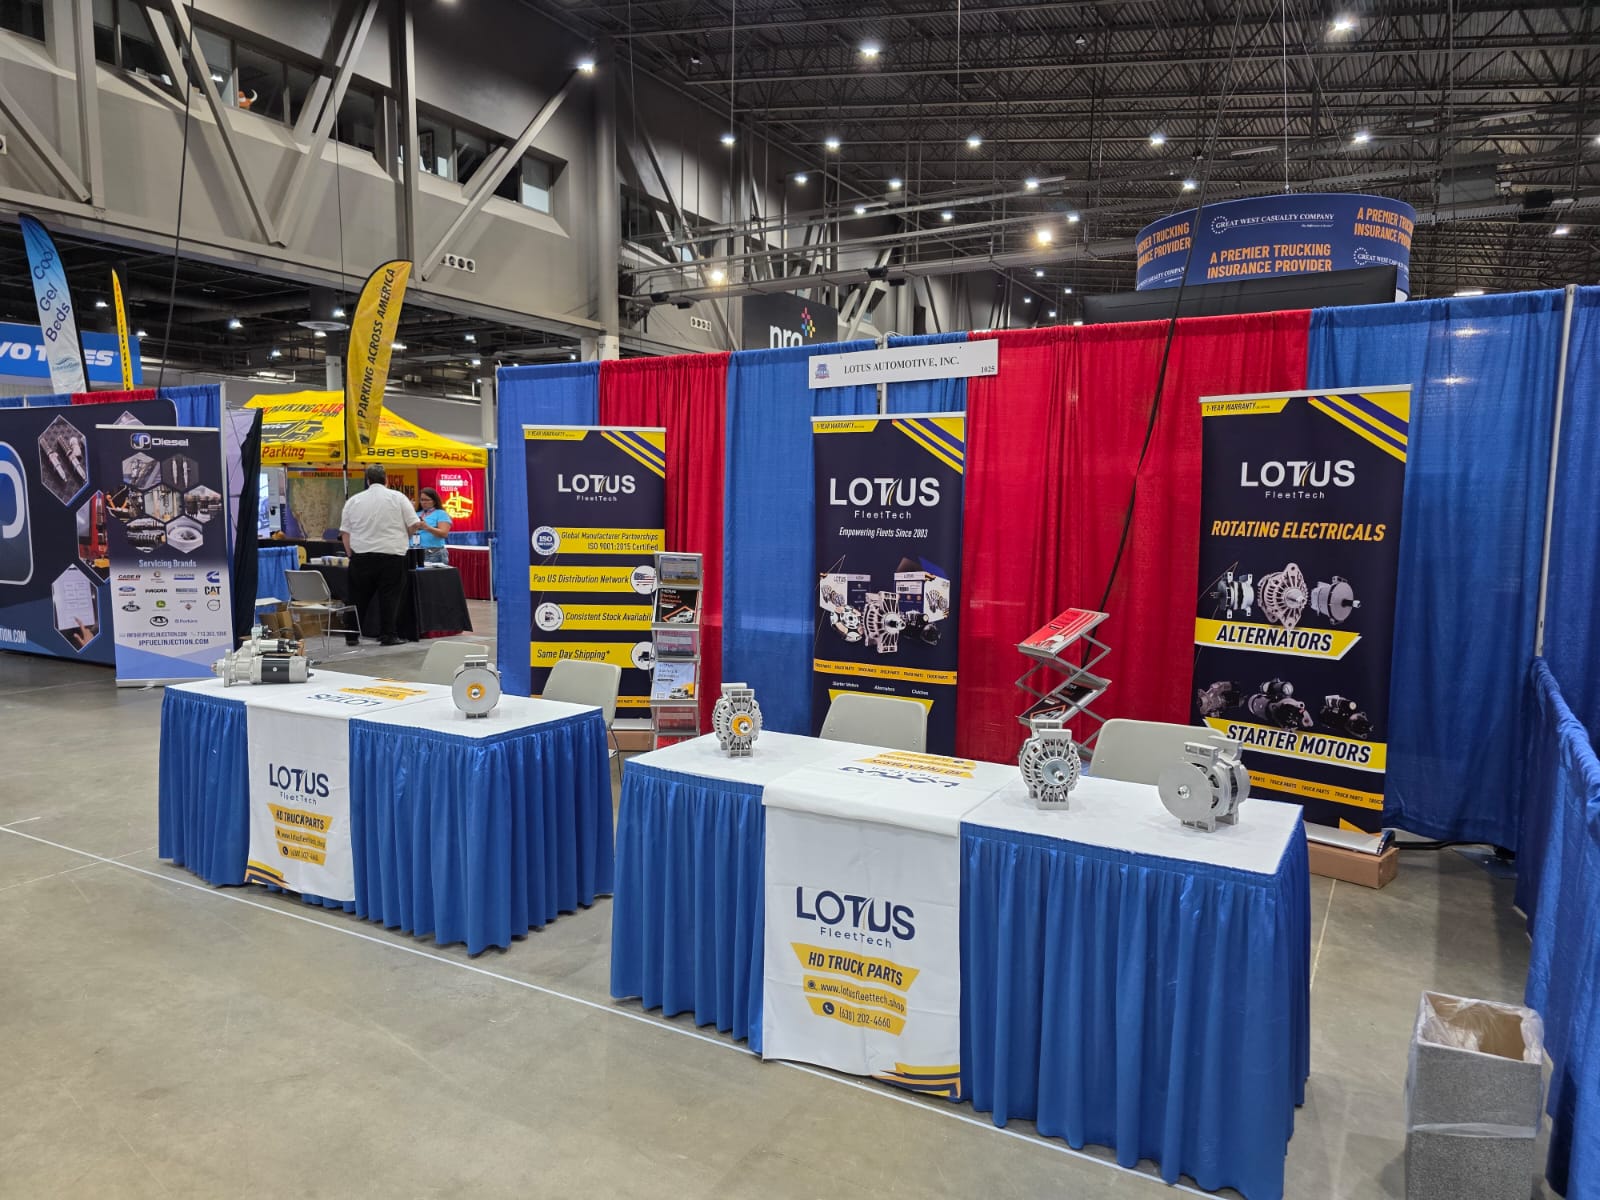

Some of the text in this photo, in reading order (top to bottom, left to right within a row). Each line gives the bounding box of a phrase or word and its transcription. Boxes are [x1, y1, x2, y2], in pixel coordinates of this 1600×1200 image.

[1216, 219, 1240, 228] GREAT
[1240, 217, 1260, 225] WEST
[1261, 214, 1298, 222] CASUALTY
[1356, 207, 1364, 220] A
[1366, 208, 1399, 227] PREMIER
[1152, 222, 1190, 244] TRUCKING
[1354, 223, 1397, 242] INSURANCE
[1154, 236, 1191, 259] PROVIDER
[1210, 244, 1332, 264] A PREMIER TRUCKING
[33, 249, 55, 280] Cool
[1207, 259, 1333, 279] INSURANCE PROVIDER
[40, 282, 58, 312] Gel
[45, 302, 71, 342] Beds
[357, 369, 375, 419] PARKING
[369, 320, 383, 365] ACROSS
[378, 268, 396, 319] AMERICA
[844, 356, 960, 374] LOTUS AUTOMOTIVE, INC.
[1226, 402, 1256, 410] WARRANTY
[152, 438, 189, 446] Diesel
[262, 444, 306, 460] Parking
[558, 474, 636, 494] LOTUS
[1240, 460, 1356, 488] LOTUS
[830, 477, 940, 507] LOTUS
[1265, 490, 1326, 499] FleetTech
[854, 510, 912, 520] FleetTech
[582, 532, 620, 540] Manufacturer
[621, 532, 659, 542] Partnerships
[839, 526, 876, 539] Empowering
[876, 527, 894, 538] Fleets
[895, 528, 912, 538] Since
[1210, 520, 1387, 542] ROTATING ELECTRICALS
[588, 542, 659, 551] ISO 9001:2015 Certified
[138, 560, 197, 568] Servicing Brands
[533, 574, 629, 584] Pan US Distribution Network
[204, 586, 221, 596] CAT
[566, 612, 601, 621] Consistent
[602, 612, 622, 621] Stock
[1216, 624, 1332, 652] ALTERNATORS
[537, 649, 558, 659] Same
[558, 650, 572, 660] Day
[1226, 724, 1372, 764] STARTER MOTORS
[269, 762, 330, 798] LOTUS
[284, 812, 304, 825] TRUCK
[304, 816, 324, 830] PARTS
[796, 886, 916, 941] LOTUS
[820, 927, 892, 948] FleetTech
[808, 952, 903, 986] HD TRUCK PARTS
[820, 984, 905, 1012] www.lotusfleettech.shop
[856, 1013, 891, 1028] 202-4660
